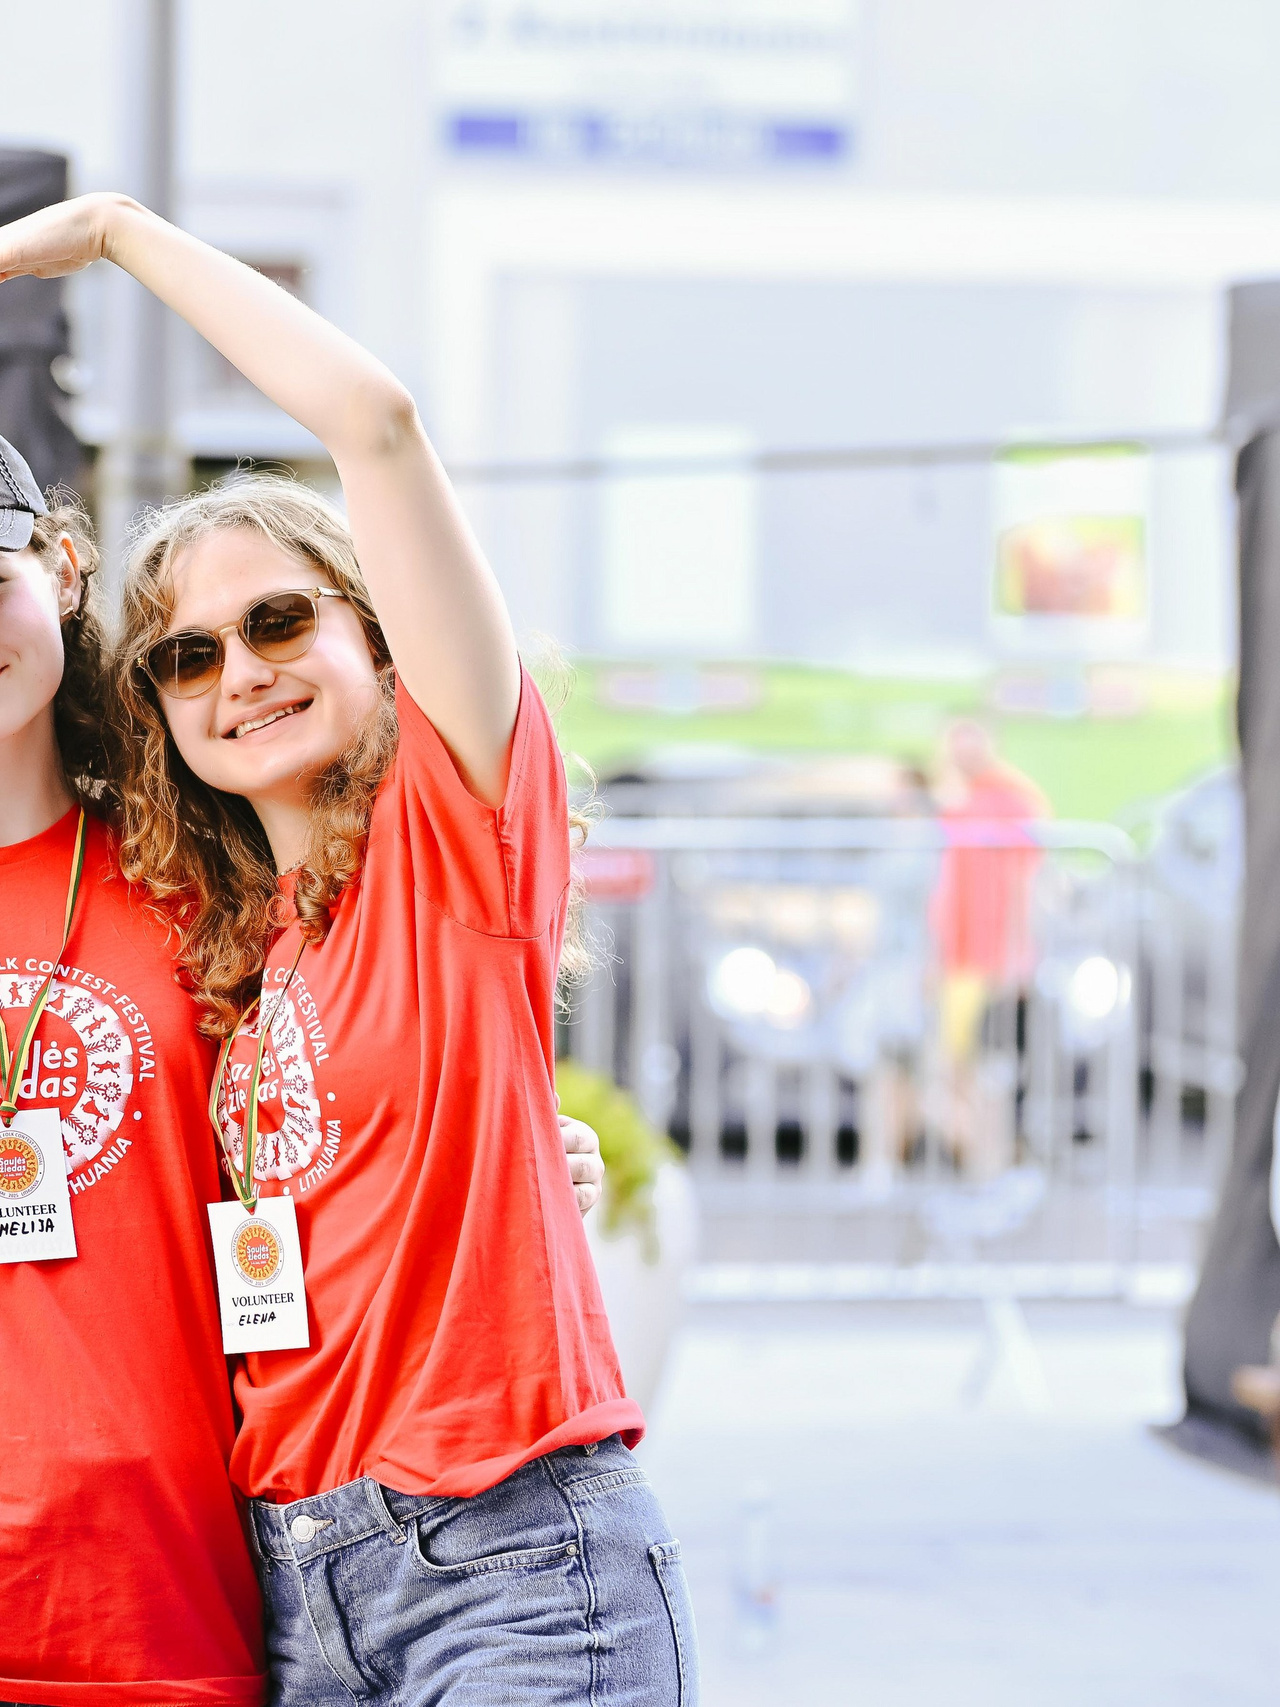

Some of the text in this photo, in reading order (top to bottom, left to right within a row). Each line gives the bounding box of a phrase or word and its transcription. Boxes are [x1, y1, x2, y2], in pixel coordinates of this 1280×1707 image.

[25, 958, 156, 1082] CONTEST-FESTIVAL
[68, 1137, 133, 1195] HUANIA
[299, 1119, 342, 1193] LITHUANIA
[232, 1292, 294, 1307] VOLUNTEER
[238, 1311, 276, 1326] ELENA
